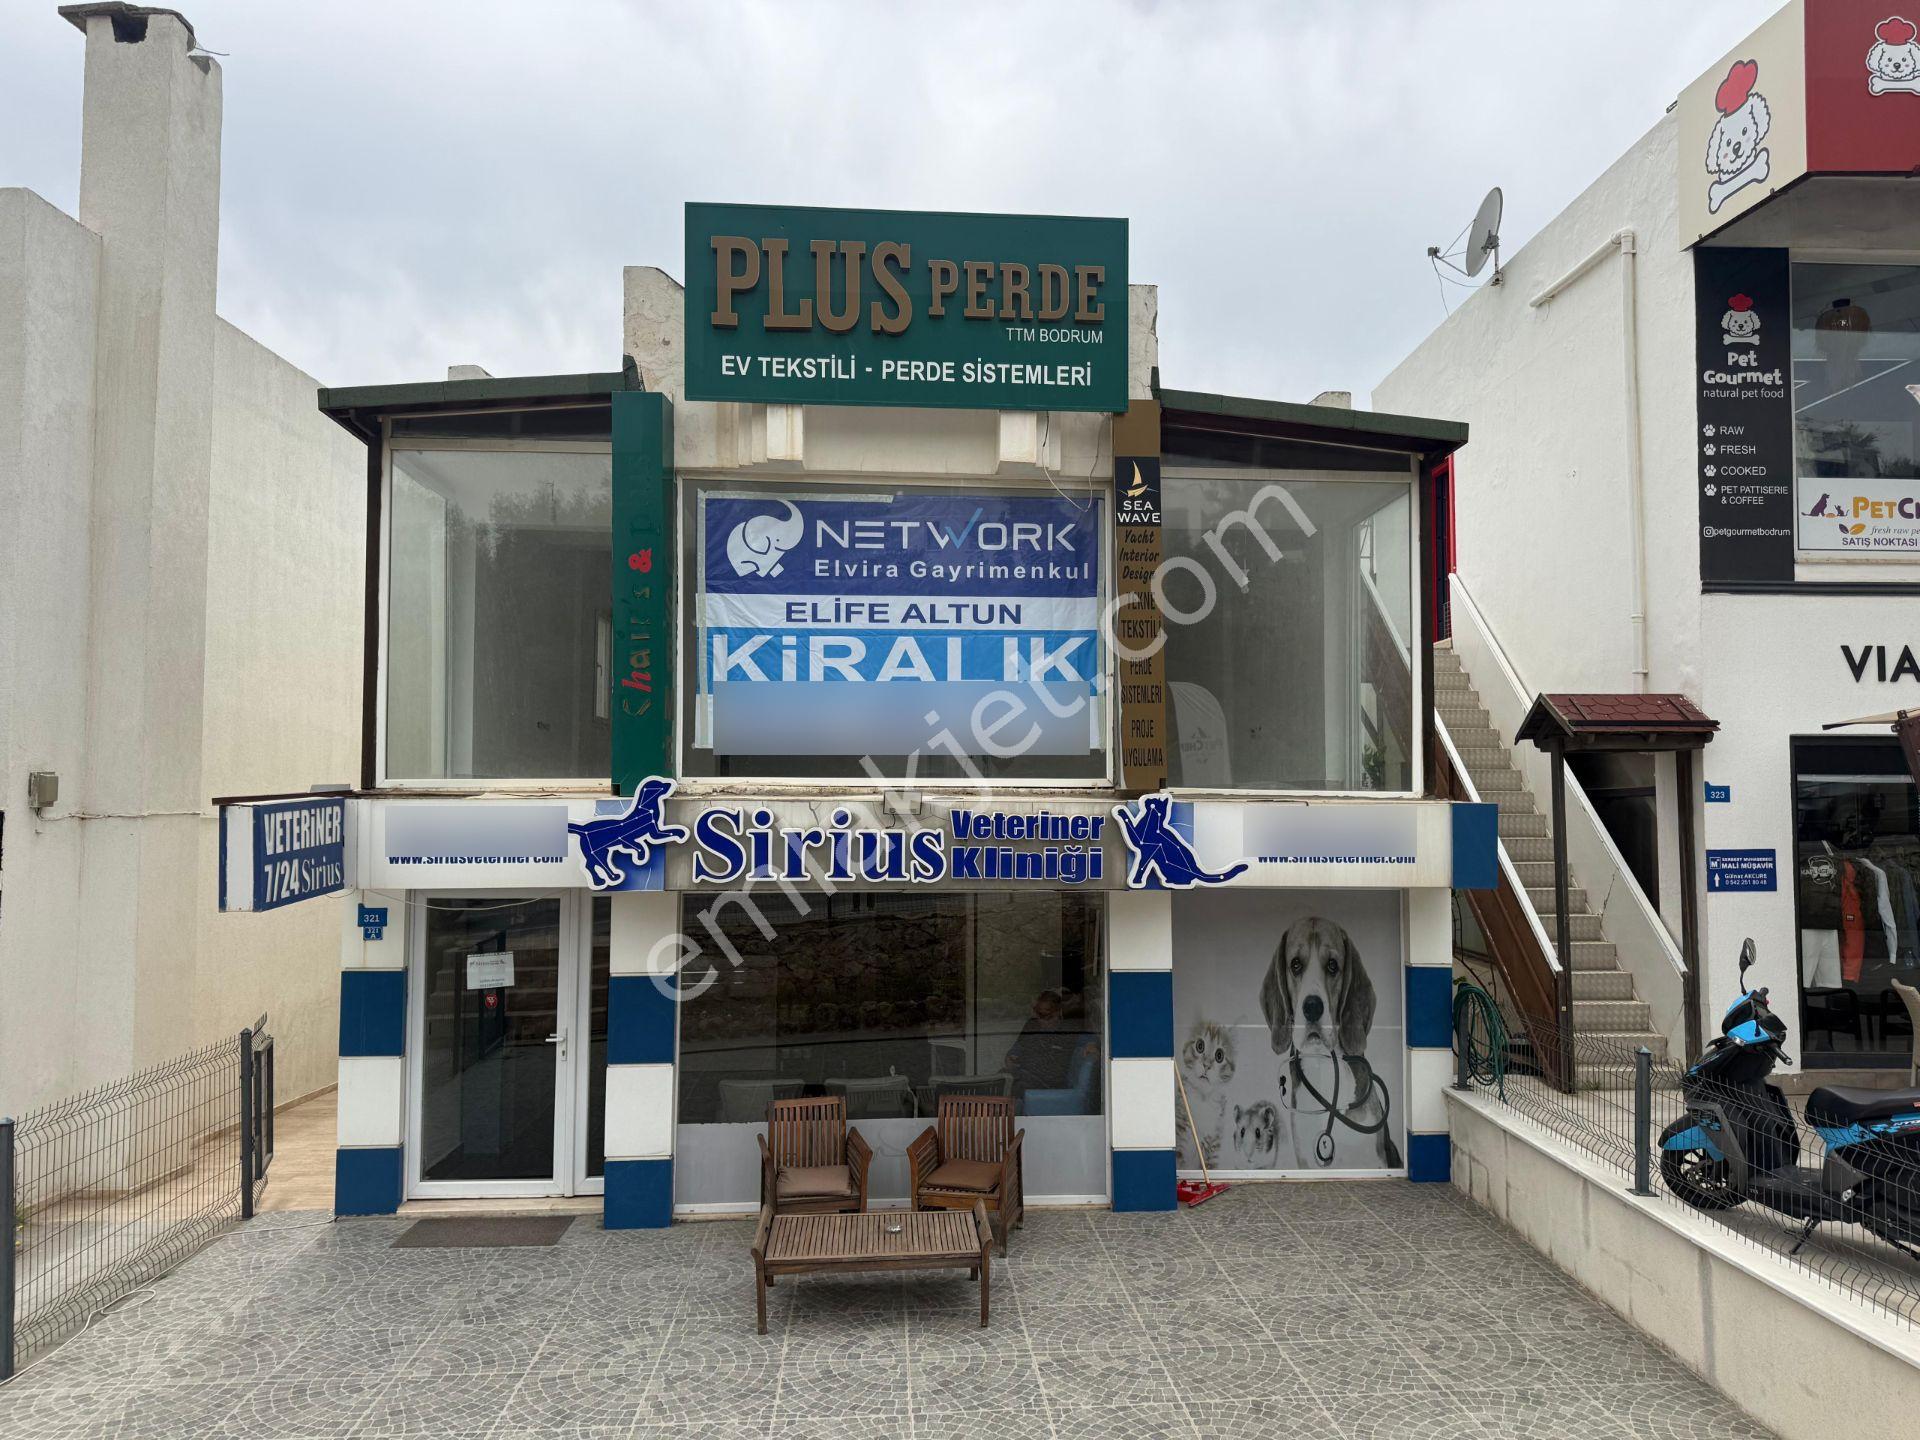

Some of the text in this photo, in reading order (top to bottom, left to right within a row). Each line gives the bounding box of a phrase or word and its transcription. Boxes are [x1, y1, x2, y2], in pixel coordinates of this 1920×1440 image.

[711, 236, 1105, 334] PLUS PERDE
[1006, 328, 1103, 344] TTM BODRUM
[1727, 350, 1758, 366] Pet
[721, 356, 751, 376] EV
[757, 354, 855, 380] TEKSTİLİ
[882, 359, 954, 382] PERDE
[963, 358, 1092, 386] SİSTEMLERİ
[1703, 369, 1783, 385] Gourmet
[1703, 388, 1784, 399] natural pet food
[1720, 426, 1744, 435] RAW
[1720, 445, 1756, 454] FRESH
[1721, 466, 1767, 476] COOKED
[1740, 486, 1789, 494] PATTISERIE
[1123, 500, 1154, 510] SEA
[1721, 496, 1764, 504] & COFFEE
[1117, 512, 1160, 523] WAVE
[816, 508, 1076, 551] NETWORK
[1124, 529, 1154, 543] Yacht
[1870, 526, 1891, 535] fresh
[1842, 538, 1918, 548] SATIŞ NOKTASI
[1119, 548, 1160, 561] Interior
[815, 559, 1089, 582] Elvira Gayrimenkul
[786, 598, 1022, 625] ELİFE ALTUN
[1840, 645, 1920, 683] VIA
[1131, 720, 1154, 738] PROJE
[1123, 748, 1163, 767] UYGULAMA
[1710, 791, 1725, 799] 323
[693, 806, 1105, 884] Sirius Veteriner
[950, 846, 1104, 883] Kliniği
[1741, 862, 1774, 870] MÜŞAVİR
[264, 856, 341, 903] 7/24 Sirius
[363, 914, 380, 923] 321
